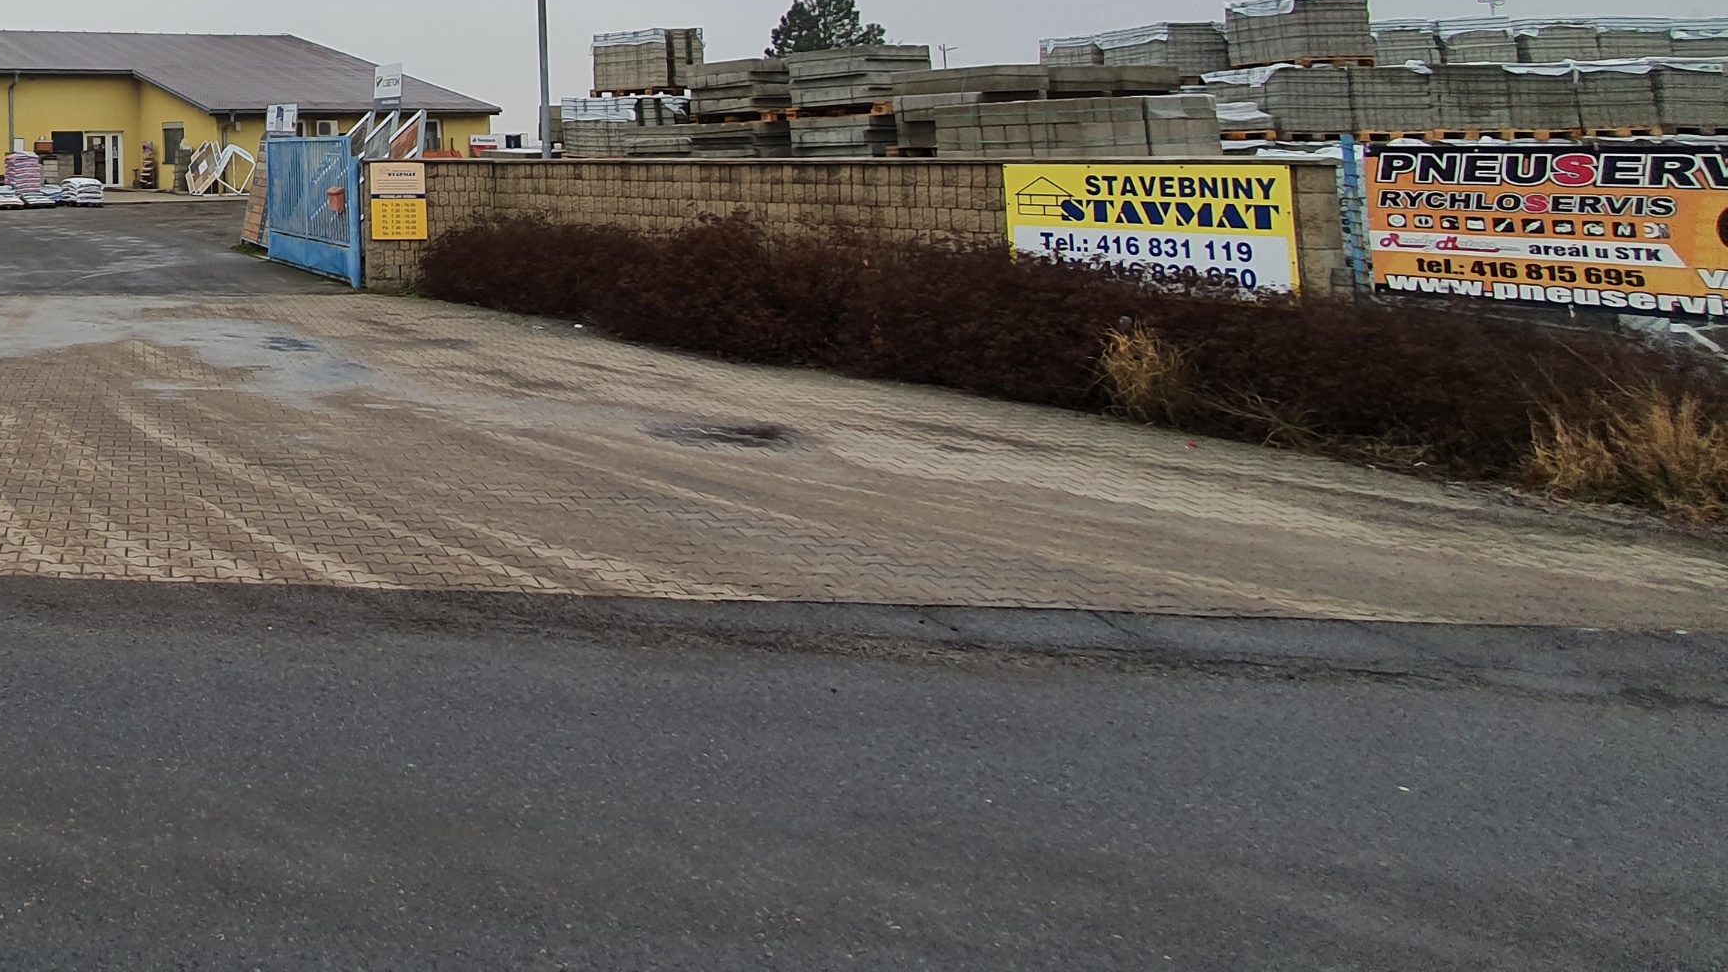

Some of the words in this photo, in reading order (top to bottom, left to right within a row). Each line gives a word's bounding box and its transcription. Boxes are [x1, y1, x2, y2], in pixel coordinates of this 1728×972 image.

[1085, 175, 1276, 200] STAVEBNINY
[1061, 199, 1280, 230] STAVMAT
[1377, 190, 1677, 218] RYCHLOSERVIS
[1040, 232, 1088, 253] Tel.:
[1096, 235, 1140, 255] 416
[1148, 238, 1191, 258] 831
[1205, 240, 1253, 263] 119
[1528, 242, 1588, 259] areál
[1594, 247, 1609, 260] u
[1615, 246, 1663, 262] STK
[1416, 258, 1465, 275] tel.:
[1470, 261, 1519, 279] 416
[1525, 264, 1577, 283] 815
[1584, 267, 1646, 288] 695
[1385, 274, 1728, 316] www.pneuservi
